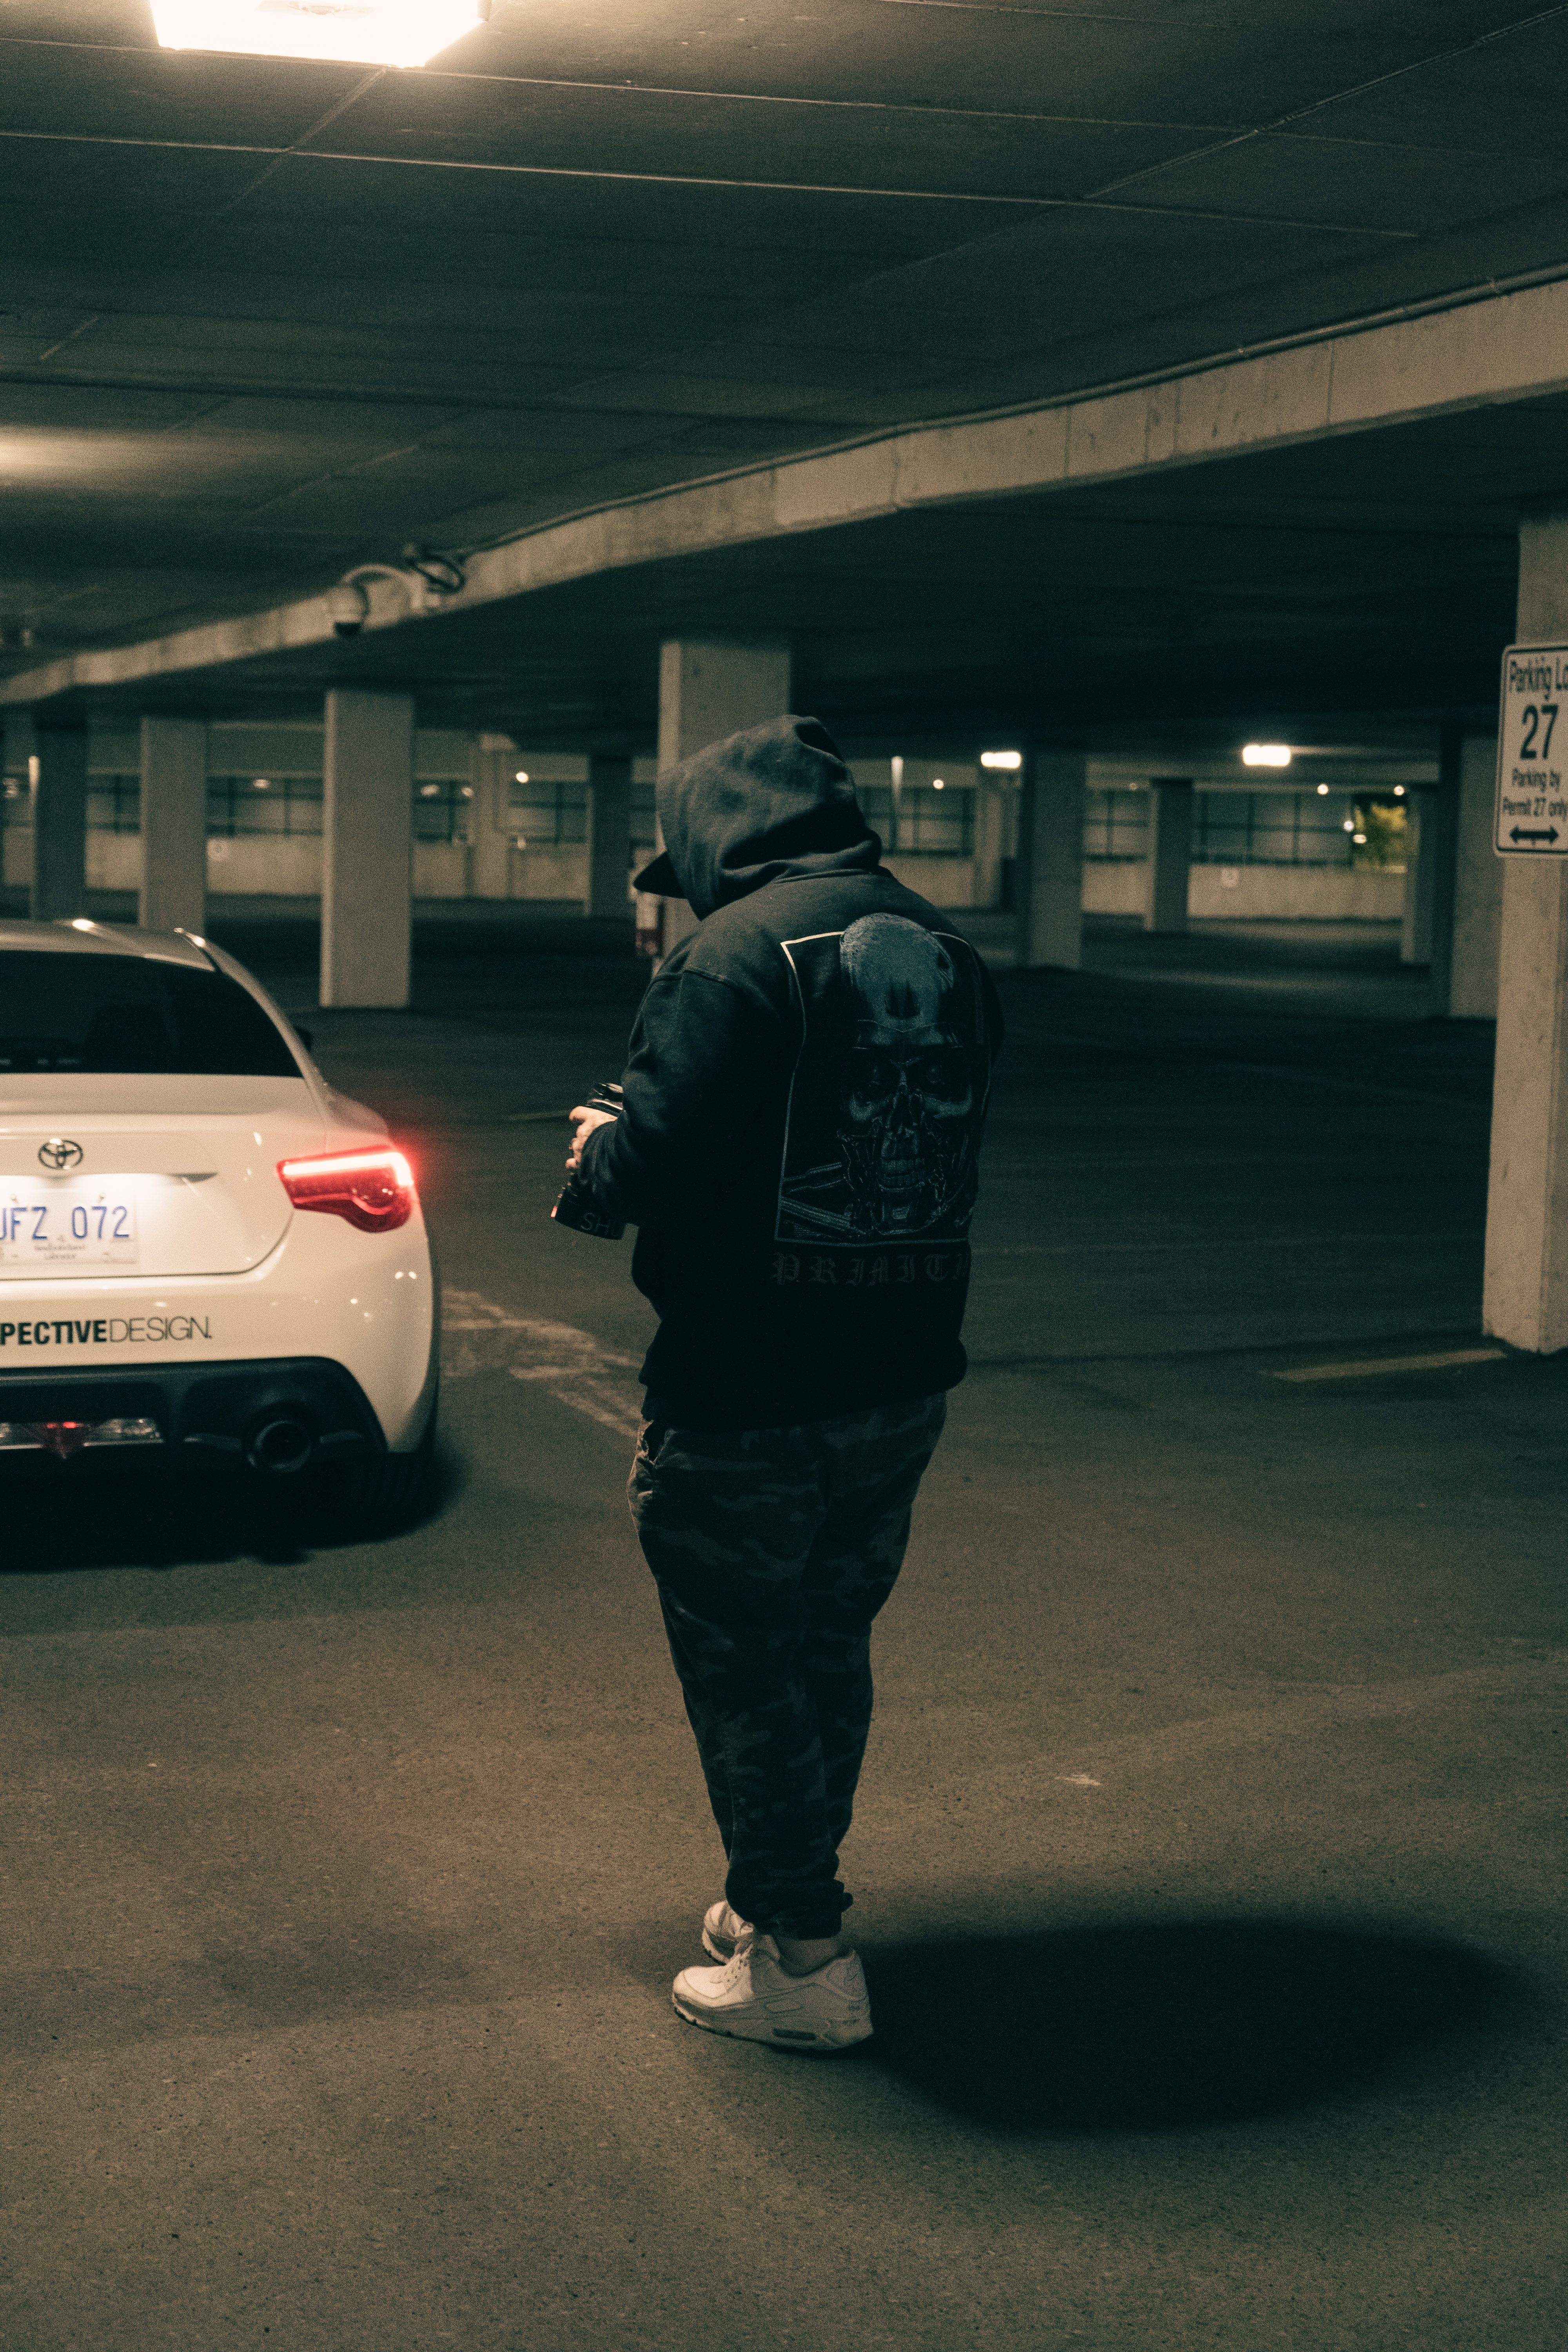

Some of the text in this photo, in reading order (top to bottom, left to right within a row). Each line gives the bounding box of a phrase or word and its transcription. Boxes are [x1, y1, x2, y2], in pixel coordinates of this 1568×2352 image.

[1509, 655, 1551, 700] Parking
[1520, 705, 1558, 759] 27
[1513, 767, 1560, 793] Parking by
[1503, 796, 1567, 822] Permit 27 only
[72, 1205, 129, 1239] 072
